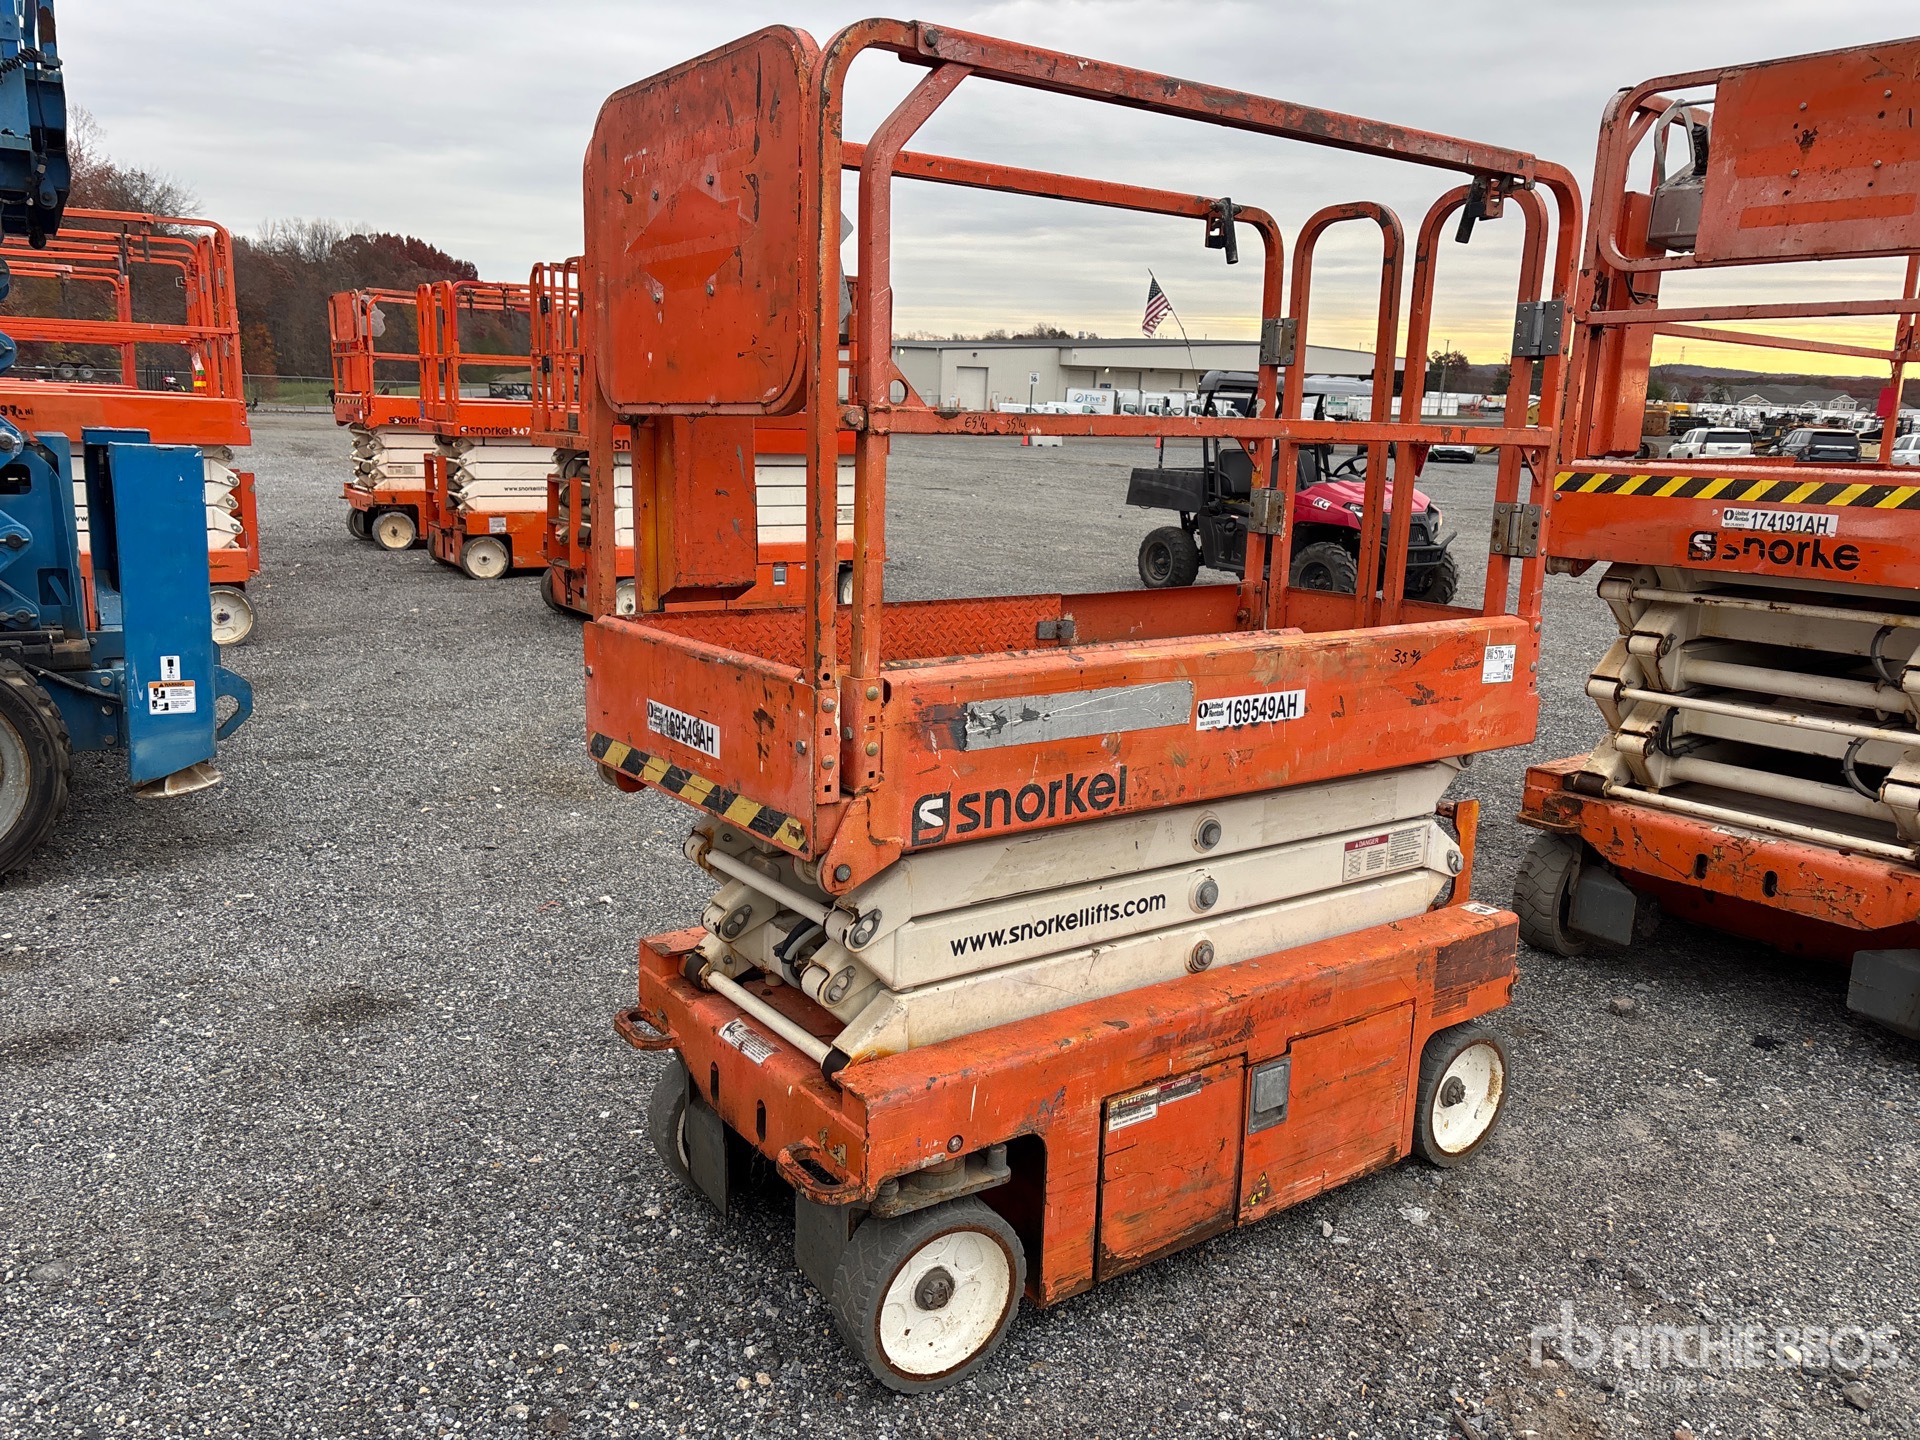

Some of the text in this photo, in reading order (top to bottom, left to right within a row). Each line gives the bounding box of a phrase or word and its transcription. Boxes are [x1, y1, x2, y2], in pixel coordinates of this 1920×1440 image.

[1084, 394, 1101, 403] Five
[470, 426, 512, 436] snorkel
[1751, 511, 1829, 535] 174191AH
[1226, 693, 1298, 725] 169549AH
[664, 709, 714, 755] 169549AH
[956, 765, 1128, 834] snorkel
[1359, 837, 1379, 847] DANGER
[950, 893, 1167, 957] www.snorkellifts.com
[1117, 1092, 1150, 1109] BATTERY
